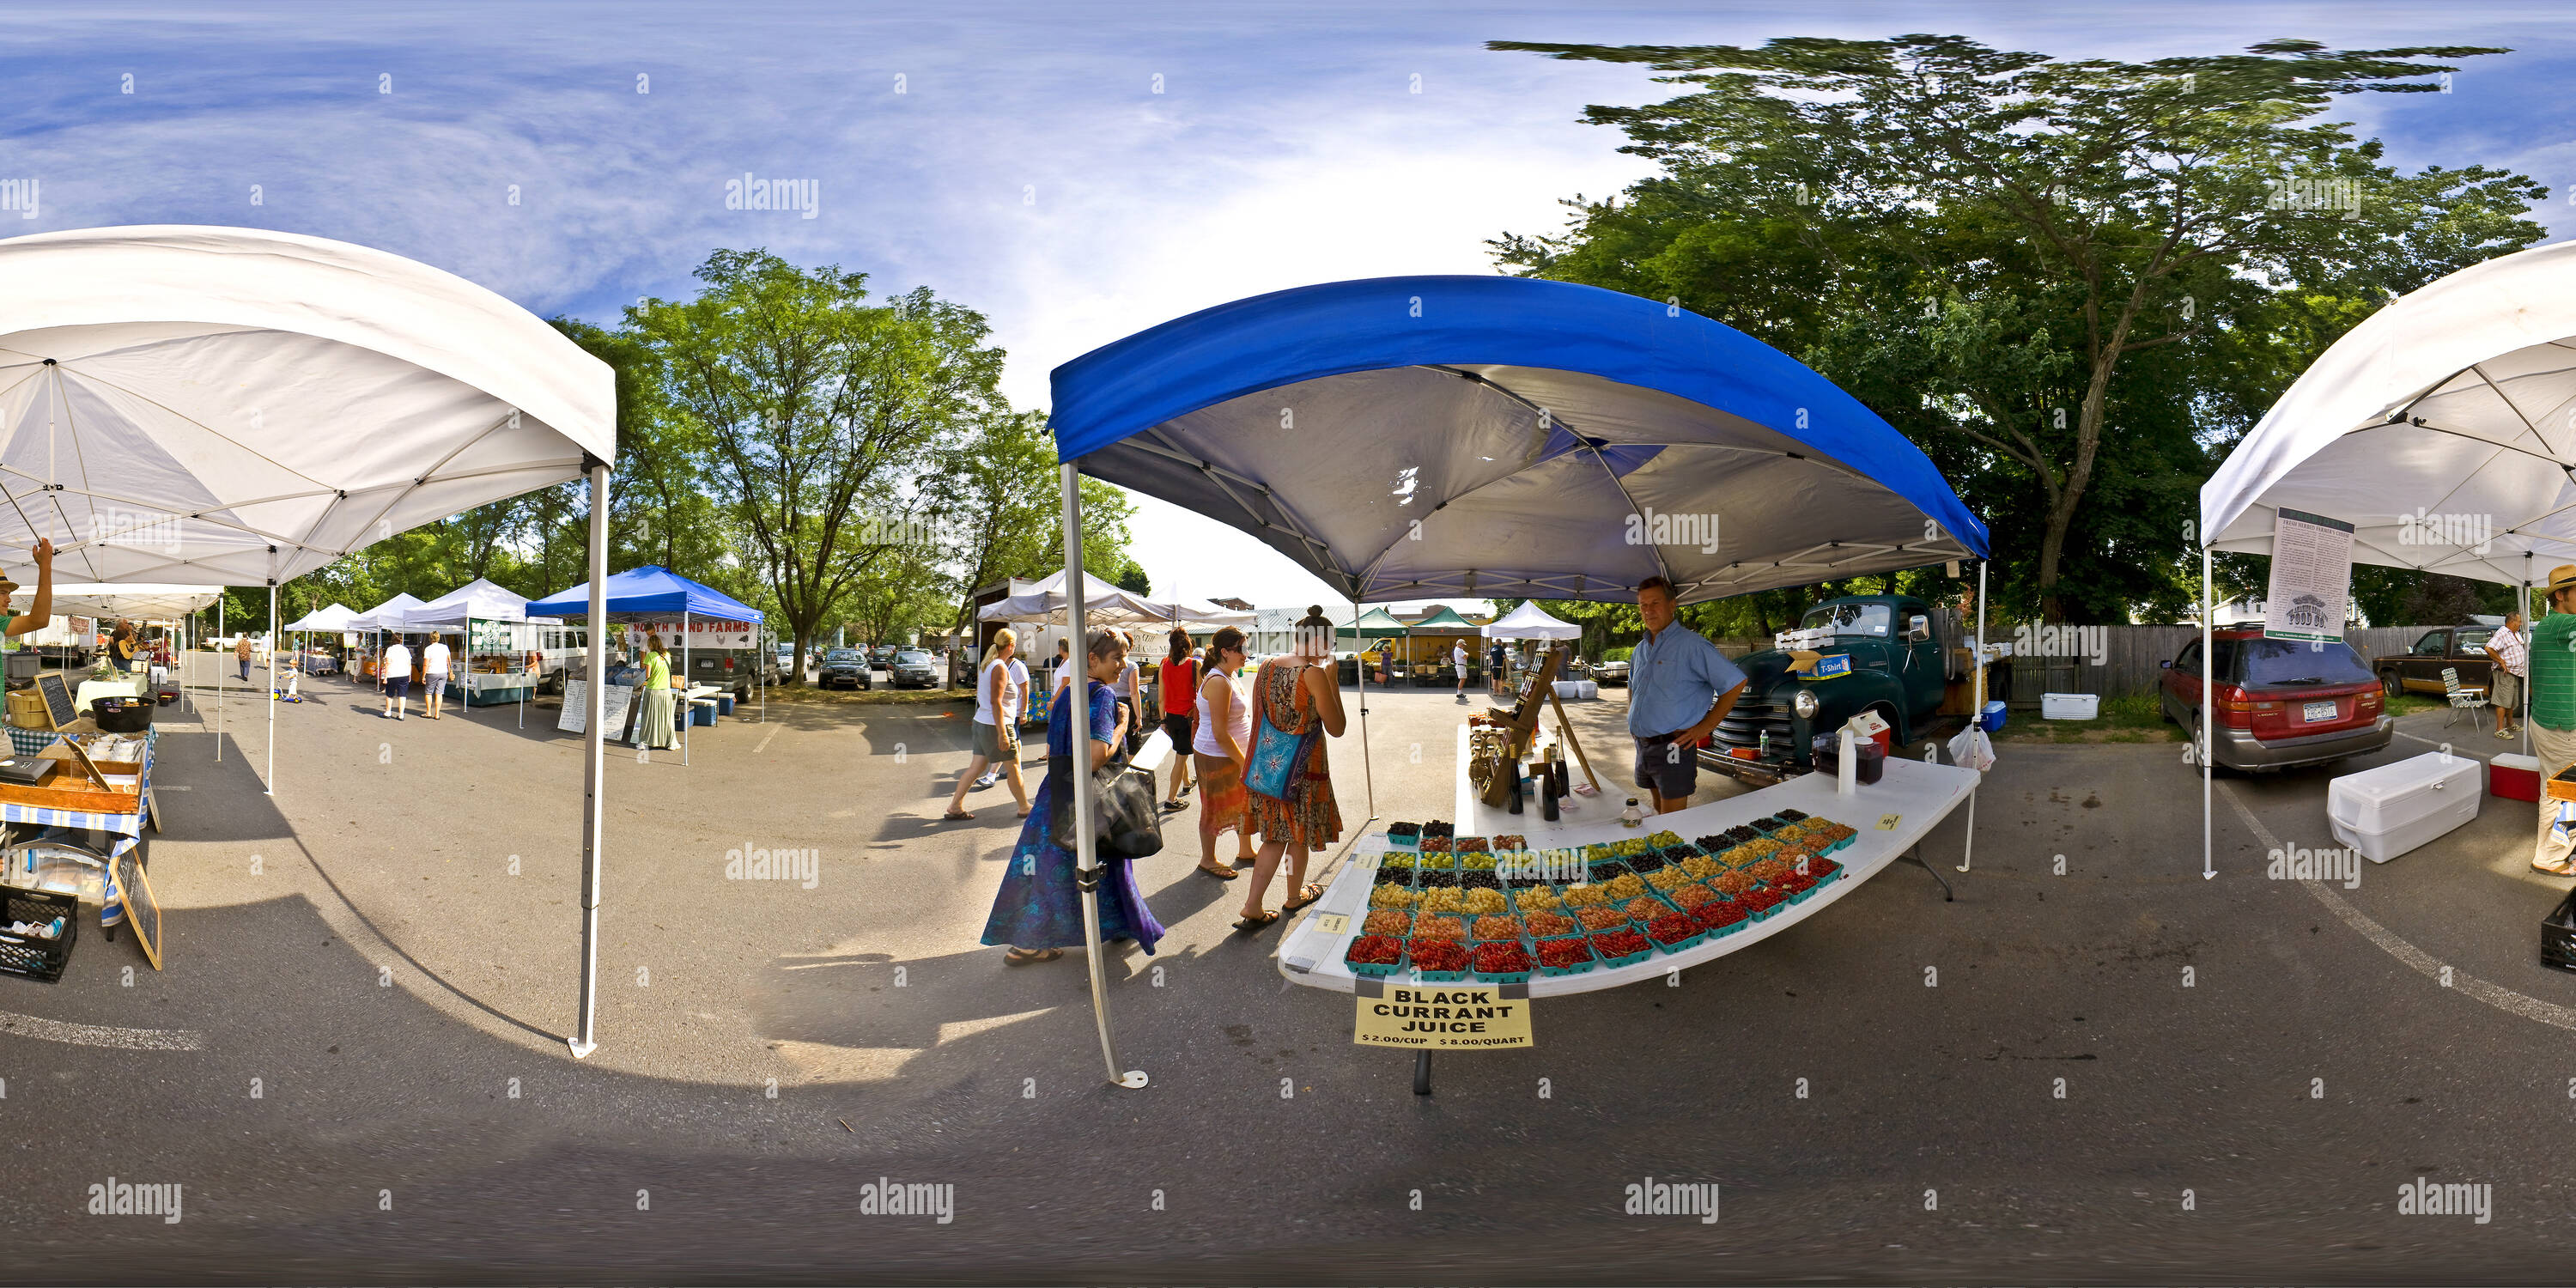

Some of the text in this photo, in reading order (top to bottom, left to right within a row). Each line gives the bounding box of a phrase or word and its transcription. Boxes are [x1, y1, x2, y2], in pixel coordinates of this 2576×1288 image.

[2289, 612, 2312, 625] FOOD
[634, 622, 750, 633] NOTH WND FARMS
[1394, 990, 1490, 1005] BLACK
[1373, 1004, 1513, 1019] CURRANT
[1400, 1021, 1485, 1033] JUICE
